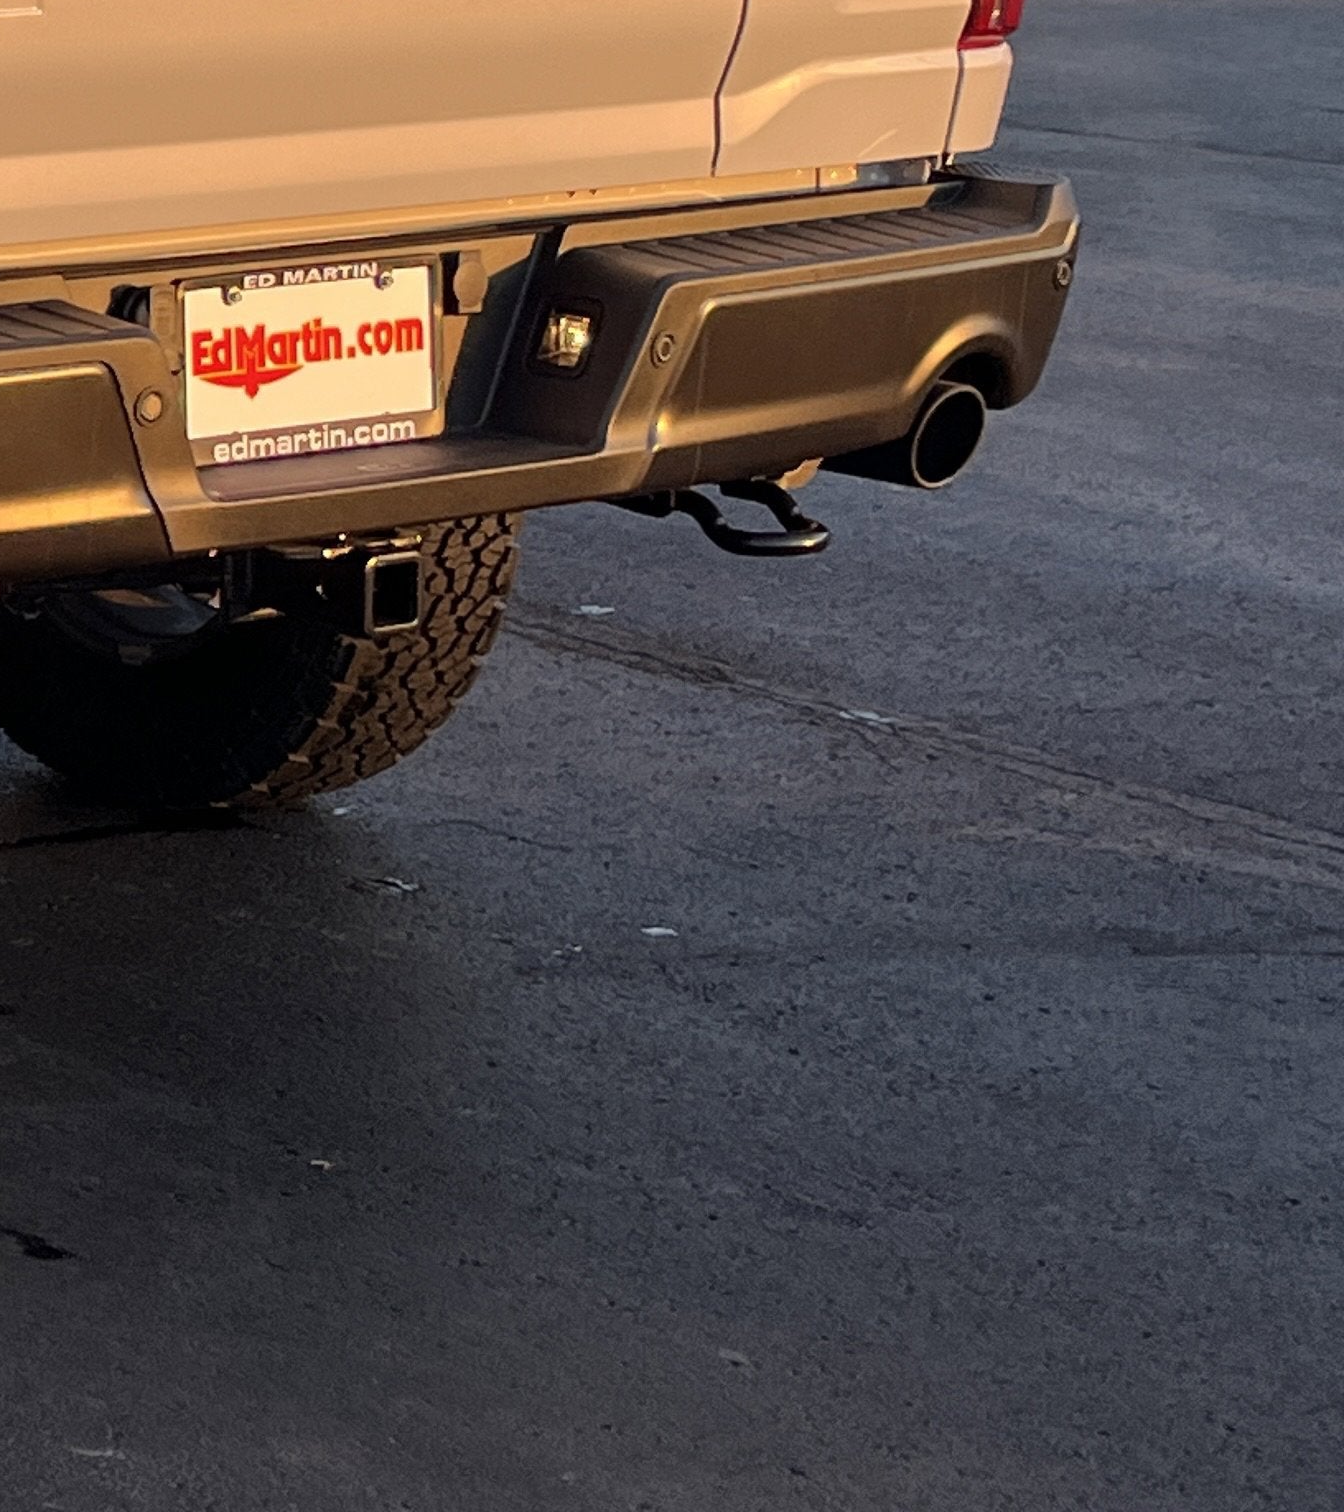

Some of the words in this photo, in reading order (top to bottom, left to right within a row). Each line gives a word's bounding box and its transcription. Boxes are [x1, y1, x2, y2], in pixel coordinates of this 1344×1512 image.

[242, 272, 276, 290] ED
[281, 262, 378, 286] MARTIN
[191, 317, 425, 379] EdMartin.com
[212, 419, 416, 463] edmartin.com
